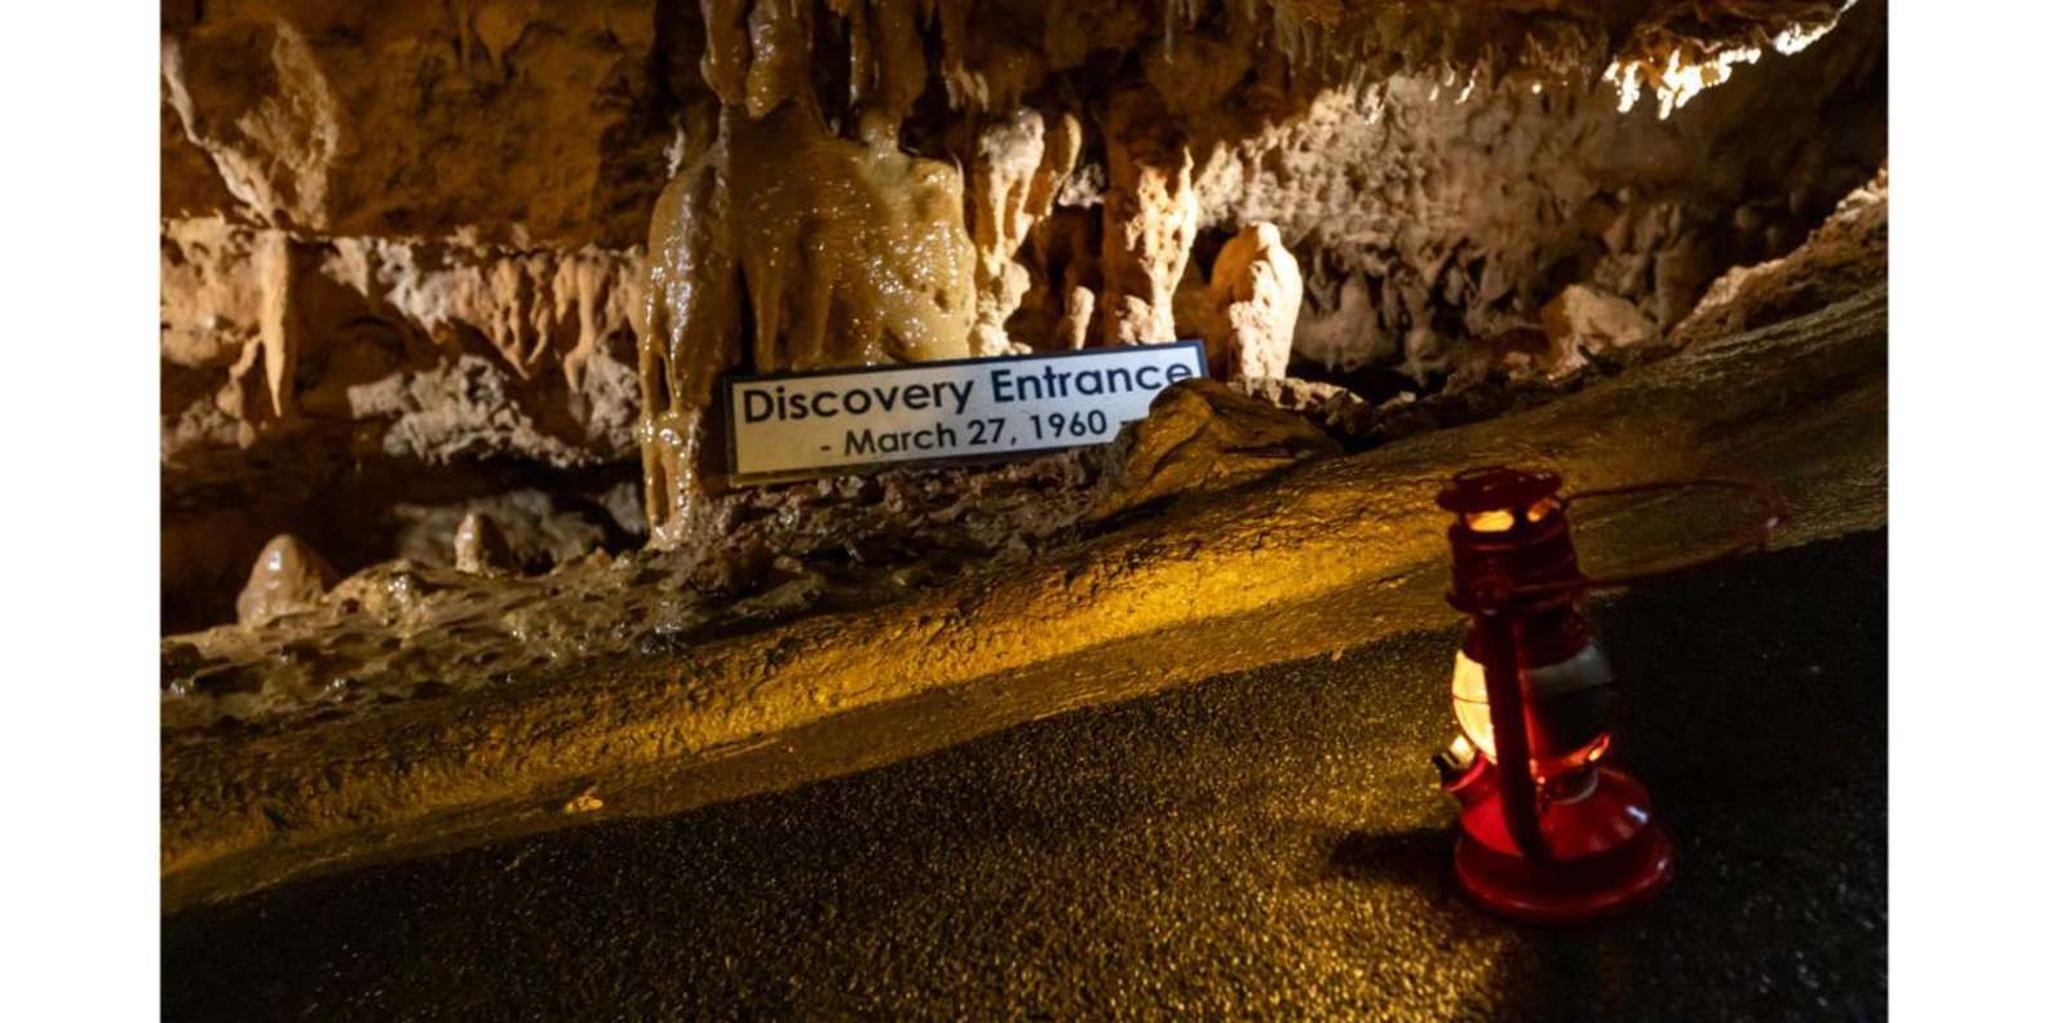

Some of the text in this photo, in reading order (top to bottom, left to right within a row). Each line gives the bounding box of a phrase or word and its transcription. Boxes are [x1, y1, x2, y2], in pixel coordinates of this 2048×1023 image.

[743, 364, 1193, 423] Discovery Entrance
[844, 423, 957, 457] March
[968, 417, 1017, 446] 27,
[1030, 410, 1107, 440] 1960
